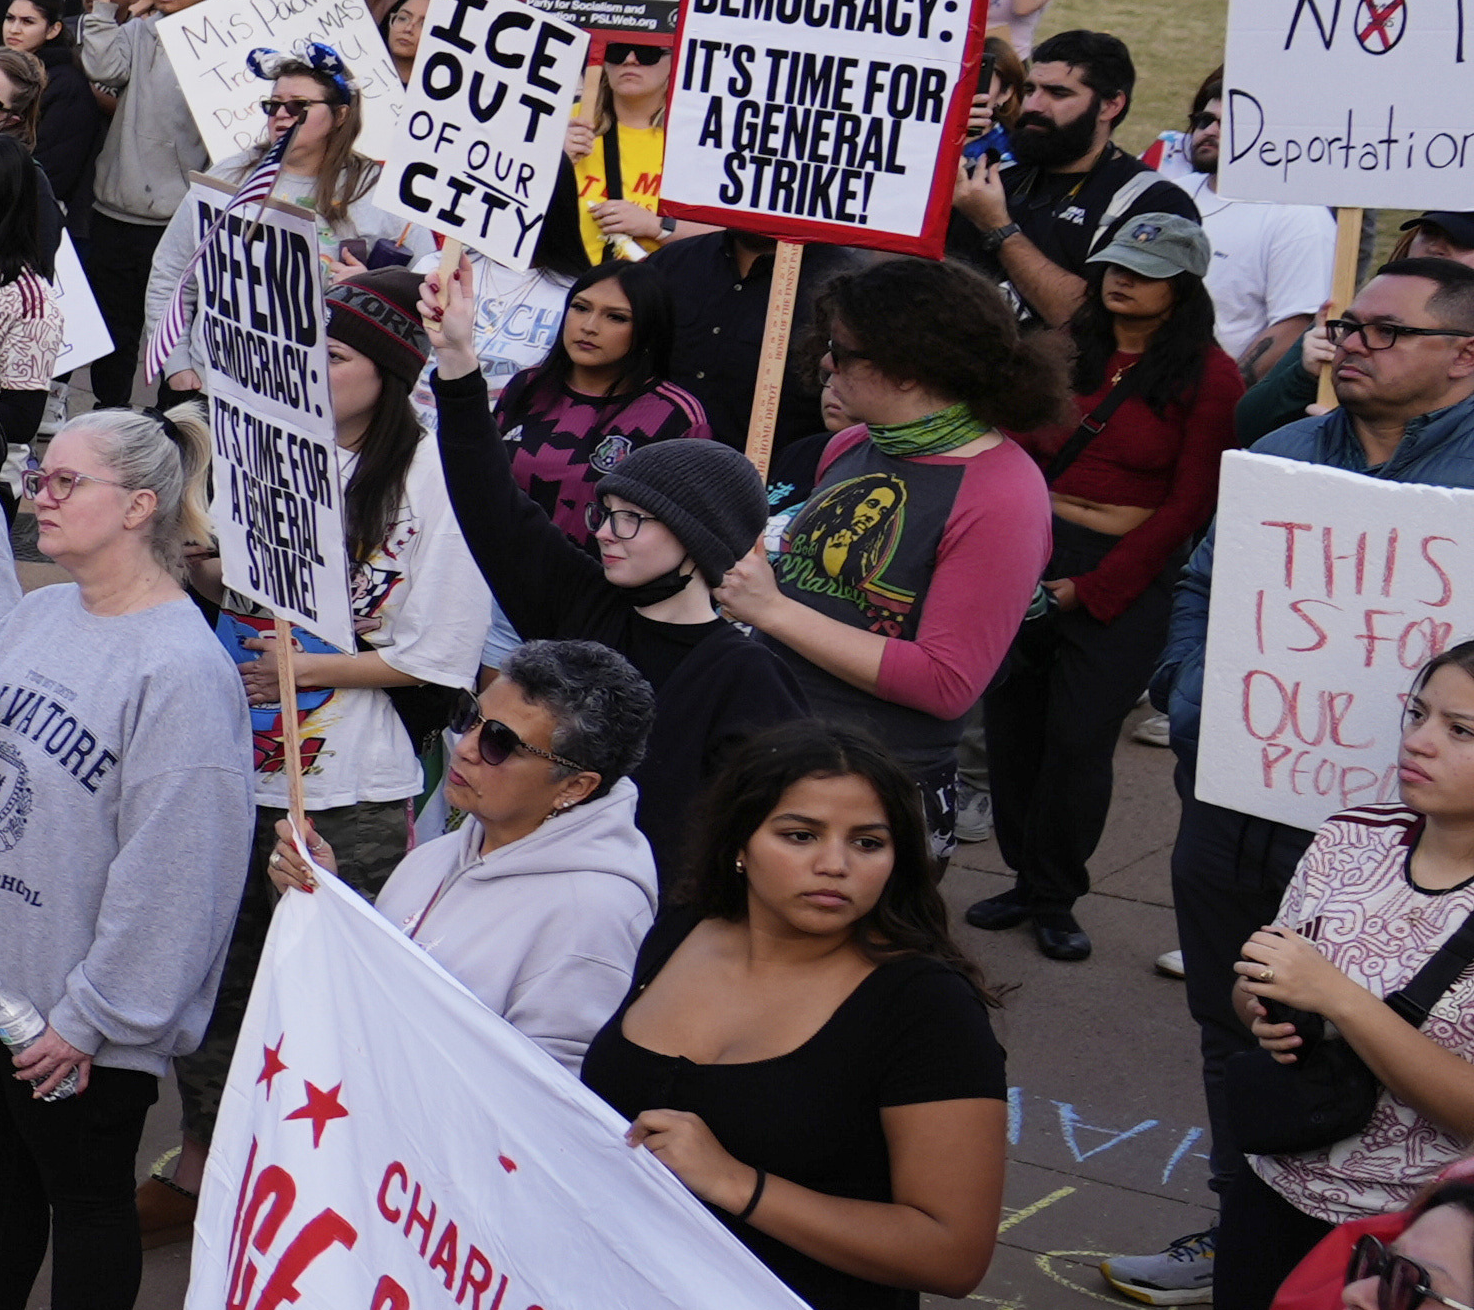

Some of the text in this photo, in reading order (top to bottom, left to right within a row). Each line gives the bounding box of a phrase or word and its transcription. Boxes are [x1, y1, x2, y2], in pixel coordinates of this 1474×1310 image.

[181, 12, 254, 61] Mis
[571, 0, 623, 13] Socialism
[623, 3, 646, 15] and
[590, 13, 658, 29] PSLWeb.org
[422, 51, 555, 143] OUT
[682, 38, 947, 124] IT'S TIME FOR
[409, 110, 461, 154] OF
[468, 140, 535, 199] OUR
[698, 95, 906, 175] A GENERAL
[399, 162, 544, 258] CITY
[719, 152, 875, 225] STRIKE!
[198, 200, 318, 348] DEFEND
[341, 287, 427, 347] YORK
[203, 318, 323, 419] DEMOCRACY:
[214, 396, 332, 510] IT'S TIME FOR
[231, 463, 324, 568] A GENERAL
[246, 531, 318, 623] STRIKE!
[779, 553, 870, 611] Marley
[1261, 520, 1456, 608] THIS
[1255, 589, 1329, 654] IS
[1241, 670, 1374, 748] OUR
